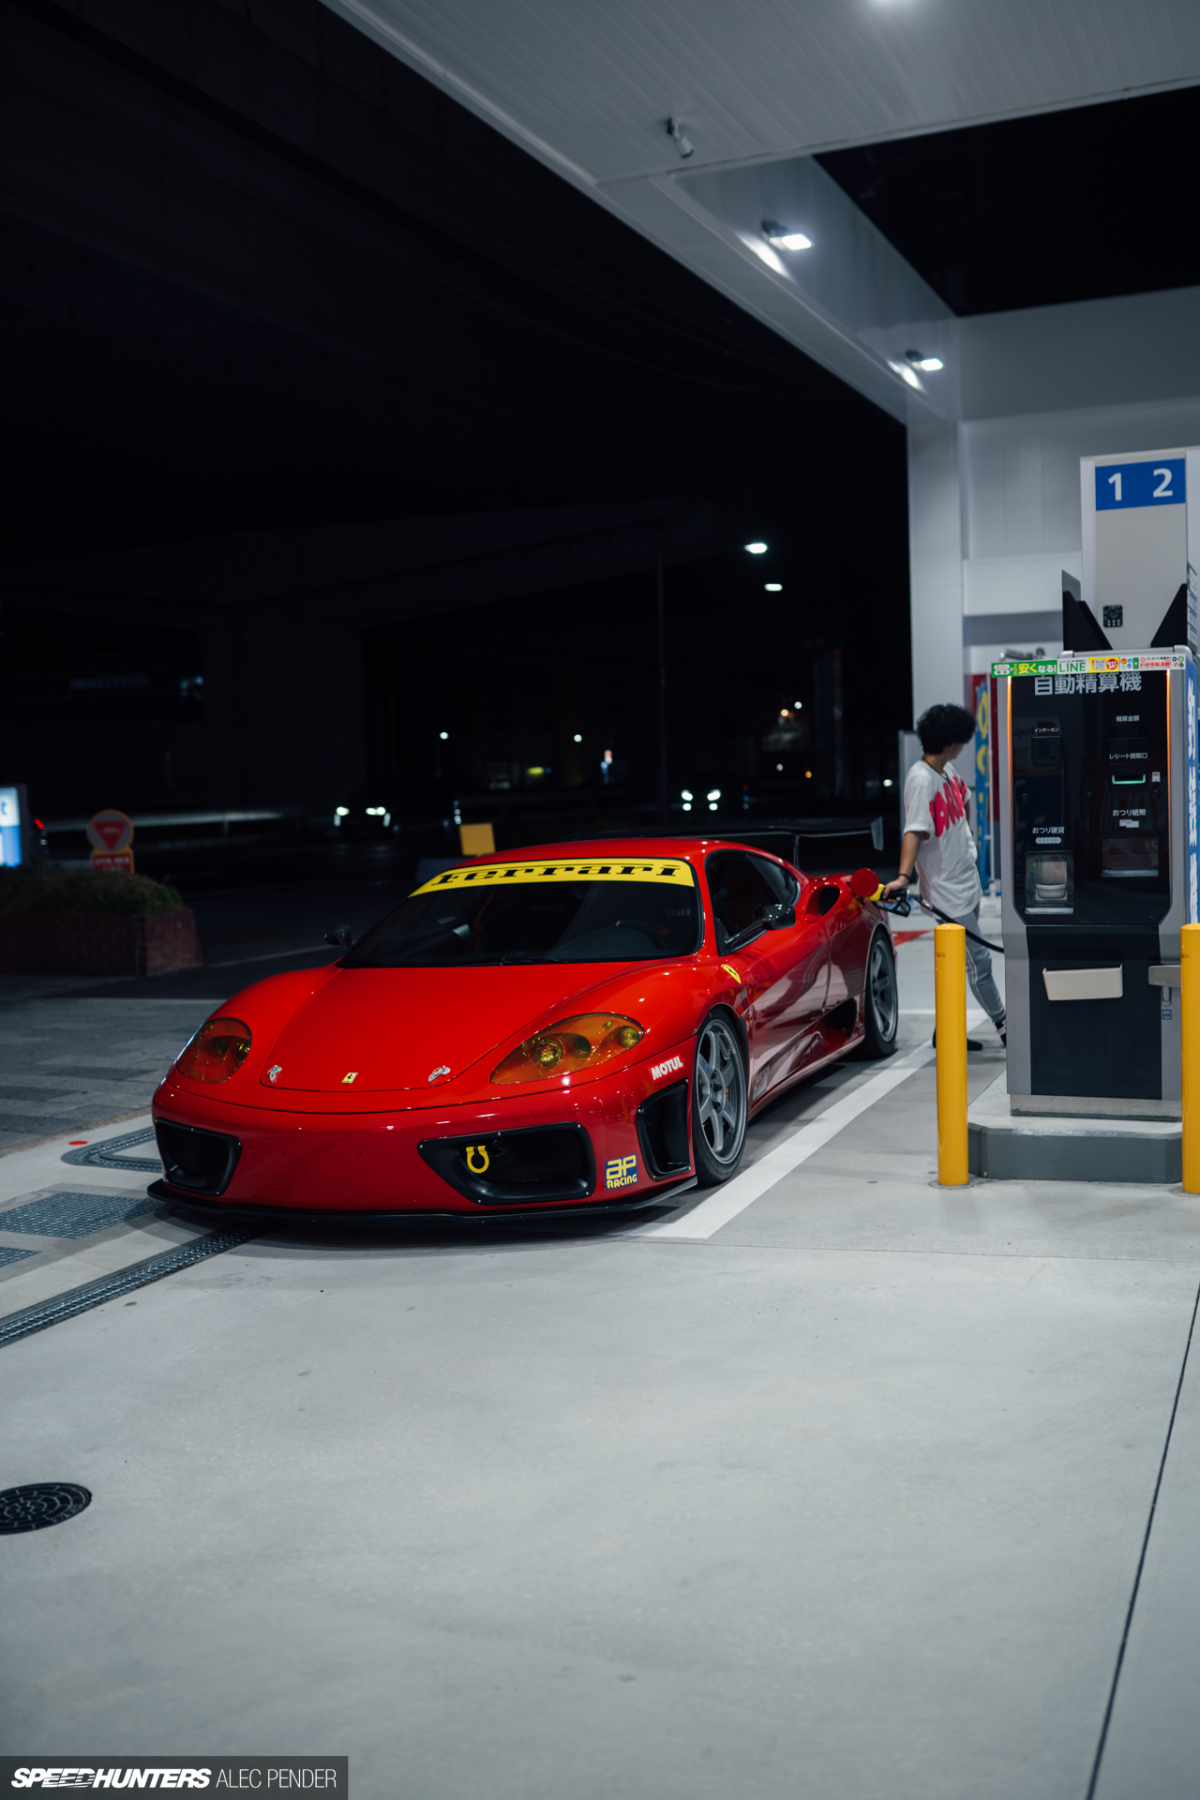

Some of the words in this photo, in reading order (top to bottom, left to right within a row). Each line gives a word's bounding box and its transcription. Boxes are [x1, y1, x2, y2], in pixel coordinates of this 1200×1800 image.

[1108, 472, 1122, 501] 1
[1153, 468, 1173, 498] 2
[1059, 662, 1086, 673] LINE
[1034, 671, 1142, 696] 自動精算機
[431, 863, 681, 886] Ferrari
[650, 1055, 684, 1081] MOTUL
[606, 1173, 638, 1190] RACING
